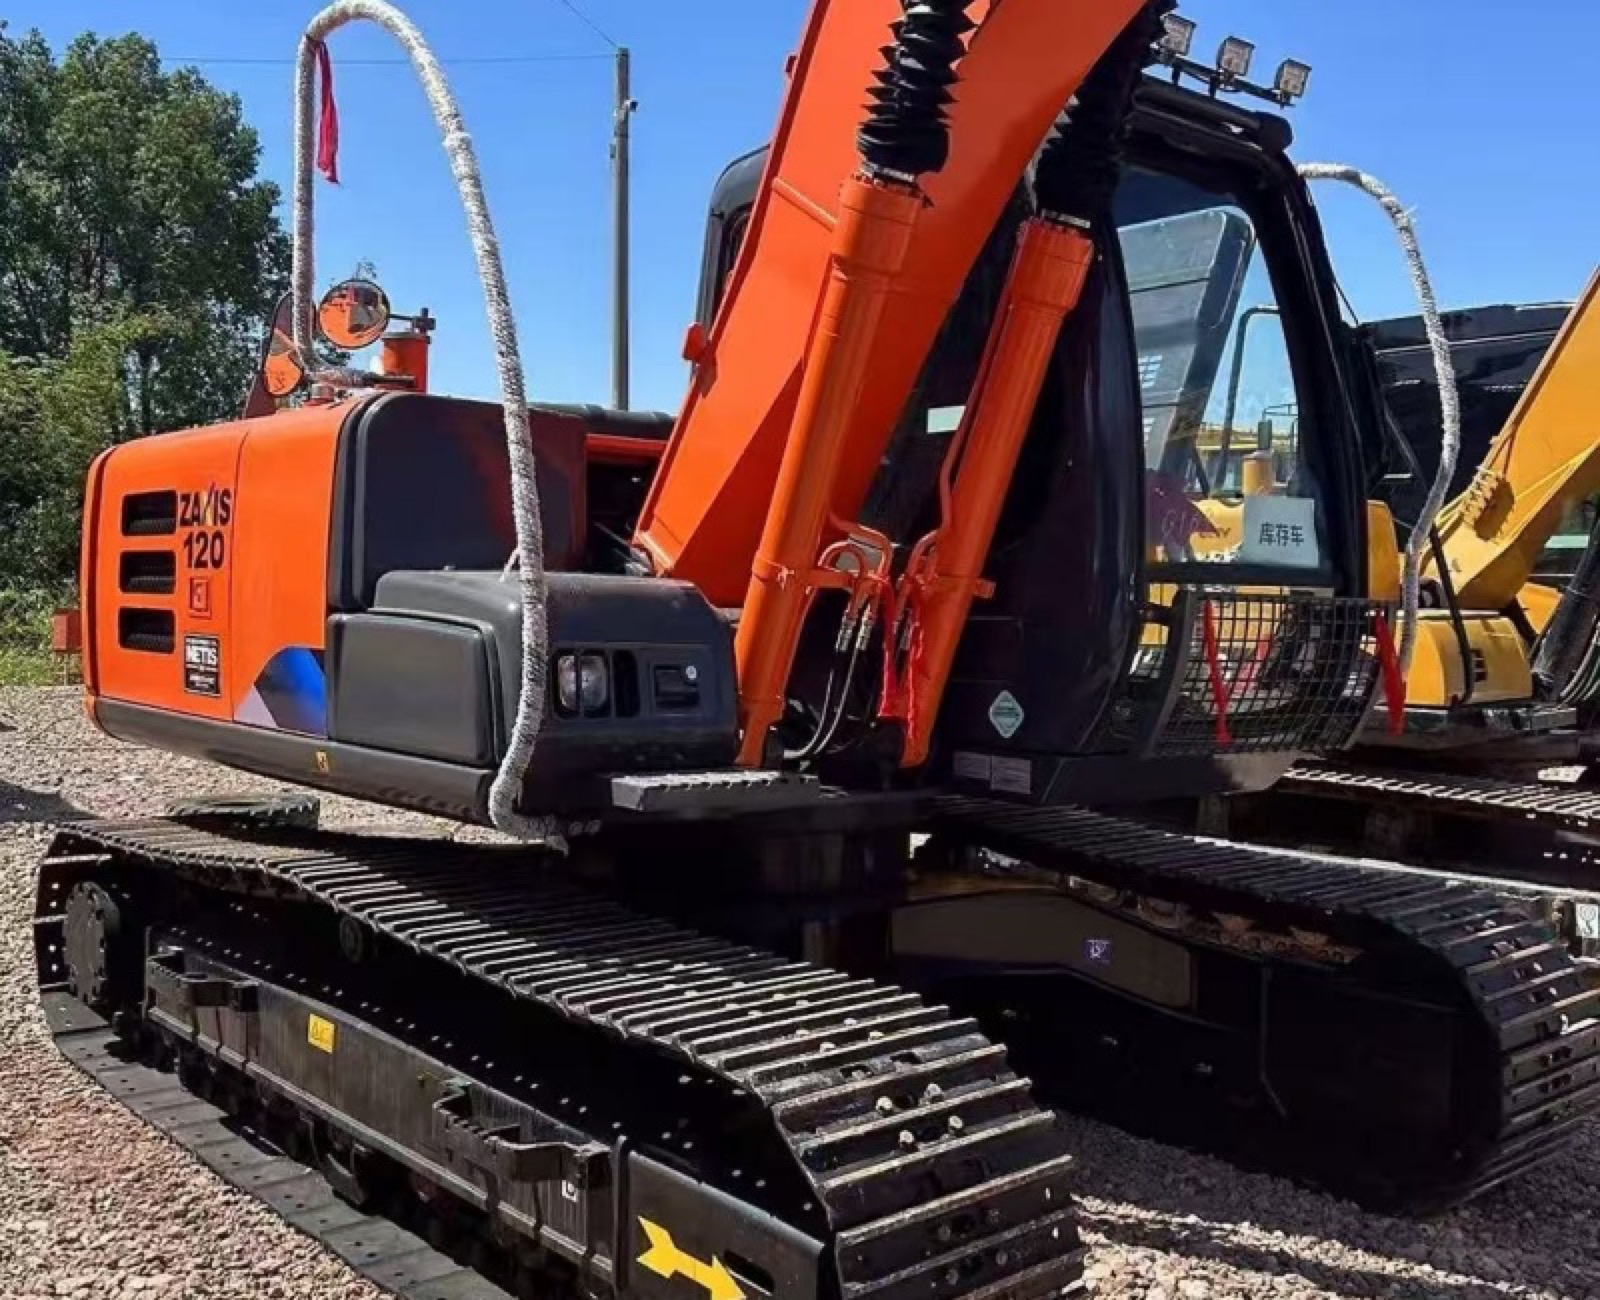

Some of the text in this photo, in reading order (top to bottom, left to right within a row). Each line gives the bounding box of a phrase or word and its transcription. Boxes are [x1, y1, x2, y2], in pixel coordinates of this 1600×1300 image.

[179, 482, 232, 527] ZAXIS
[184, 530, 224, 569] 120
[1259, 522, 1304, 547] 库存车
